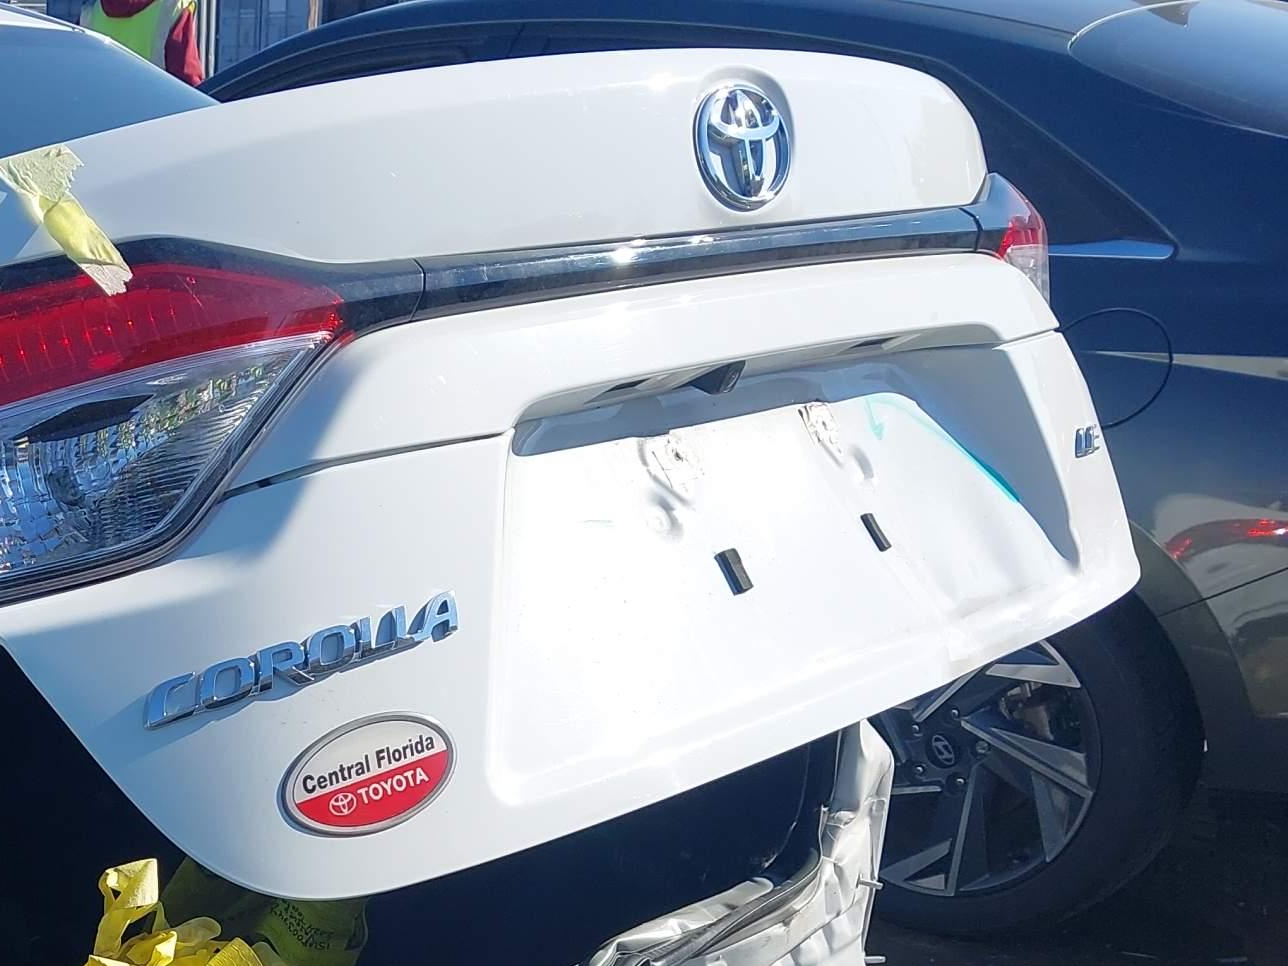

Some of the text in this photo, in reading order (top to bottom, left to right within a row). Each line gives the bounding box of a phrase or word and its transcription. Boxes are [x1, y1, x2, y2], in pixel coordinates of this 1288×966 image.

[143, 590, 460, 729] COROLLA
[302, 734, 436, 794] Central Florida
[357, 767, 430, 805] TOYOTA
